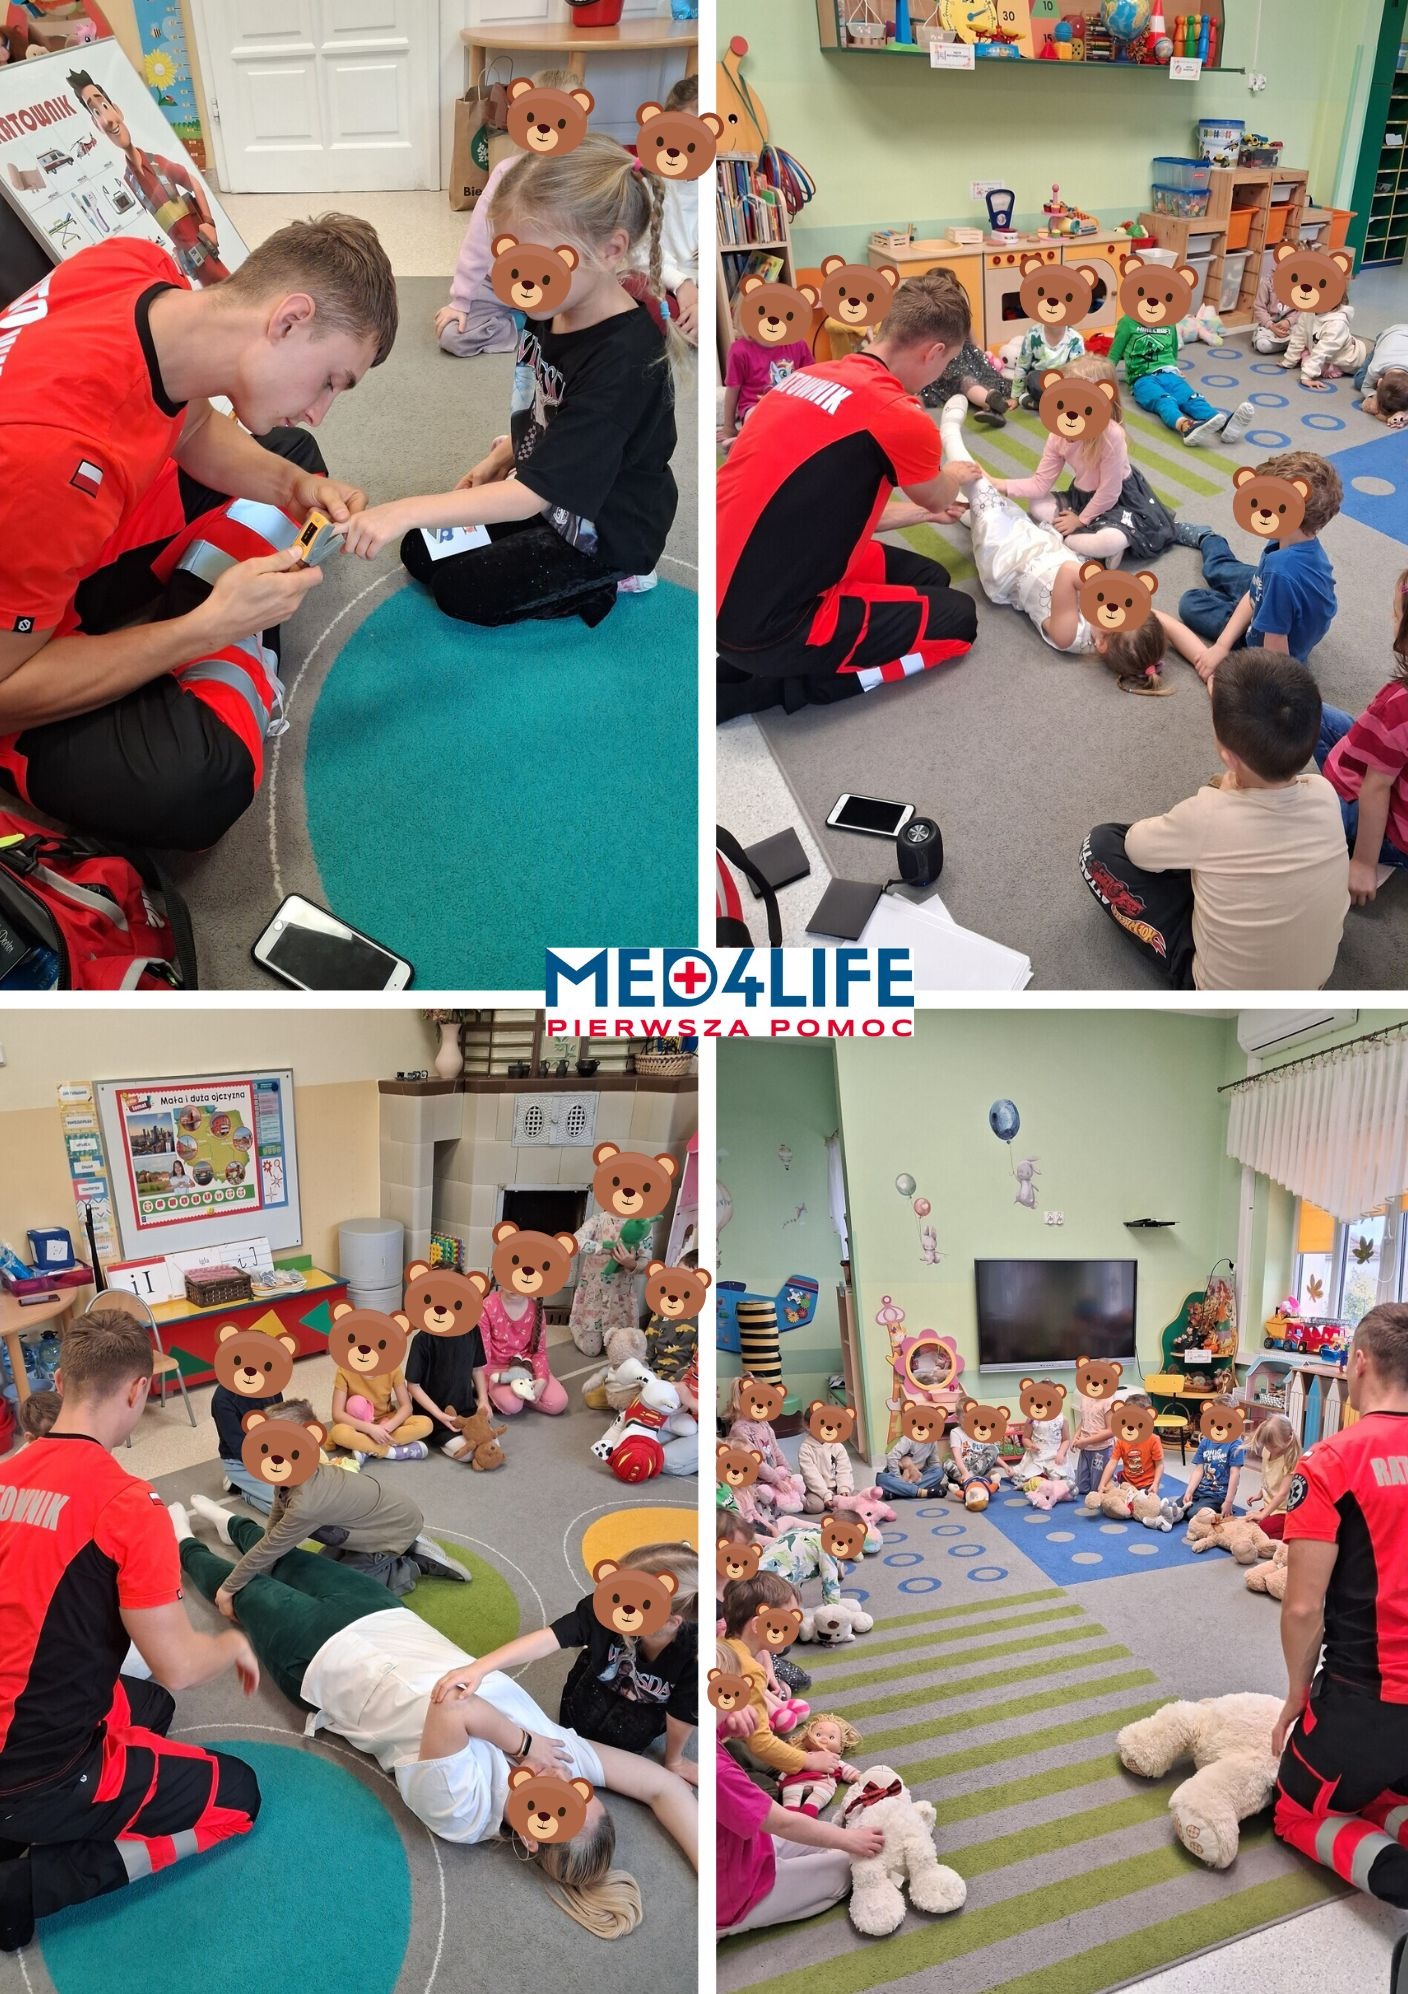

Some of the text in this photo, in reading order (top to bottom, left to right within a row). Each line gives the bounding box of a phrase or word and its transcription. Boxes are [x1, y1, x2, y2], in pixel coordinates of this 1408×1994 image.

[1042, 0, 1054, 11] 10
[1002, 10, 1016, 22] 30
[0, 94, 77, 144] ATOWNIK
[160, 1096, 184, 1105] Mała
[190, 1093, 210, 1103] duża
[211, 1091, 246, 1102] ojczyzna
